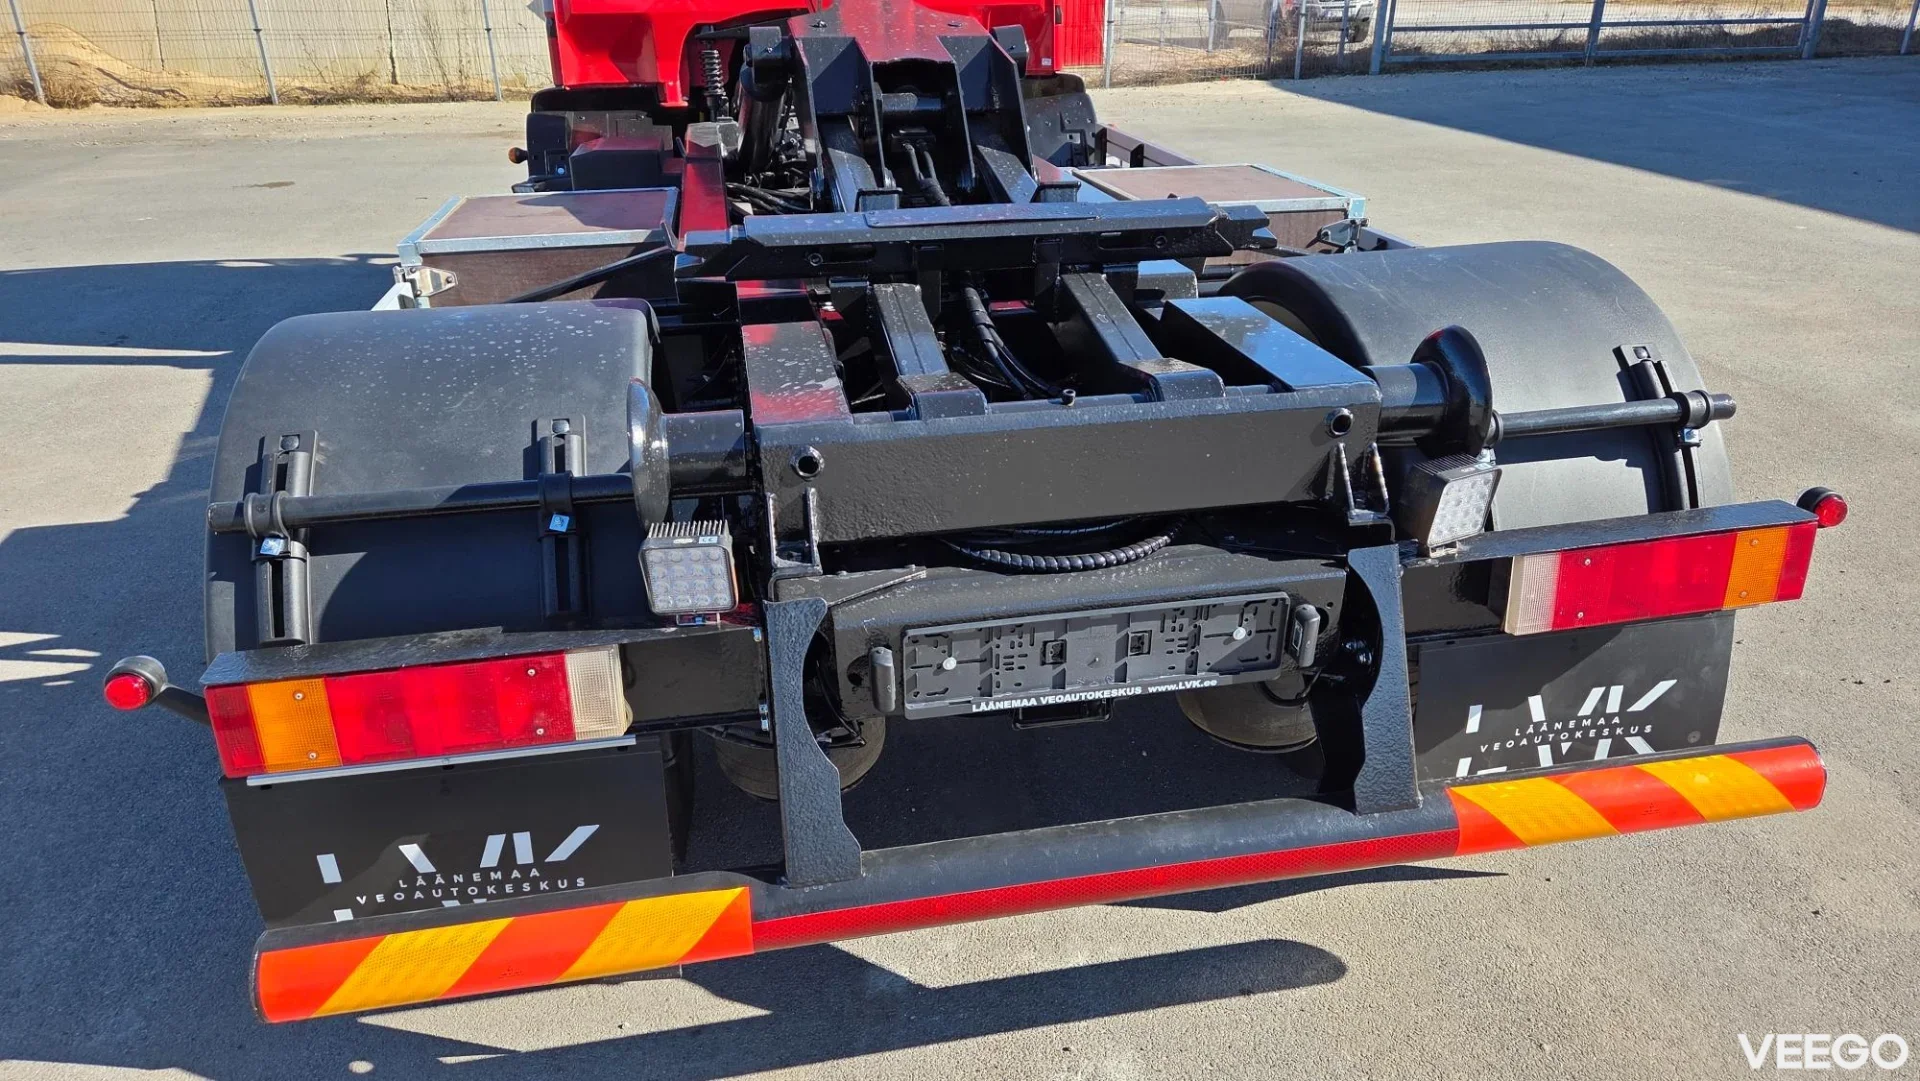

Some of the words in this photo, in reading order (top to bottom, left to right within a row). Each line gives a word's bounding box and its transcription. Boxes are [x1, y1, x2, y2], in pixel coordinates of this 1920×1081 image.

[972, 697, 1038, 712] LÄÄNEMAA
[1040, 686, 1142, 704] VEOAUTOKESKUS
[1148, 679, 1218, 693] www.LVK.ee
[1480, 725, 1652, 752] VEOAUTOKESKUS
[1514, 716, 1621, 736] LÄÄNEMAA
[356, 877, 586, 905] VEOAUTOKESKUS
[399, 868, 541, 888] LÄÄNEMAA
